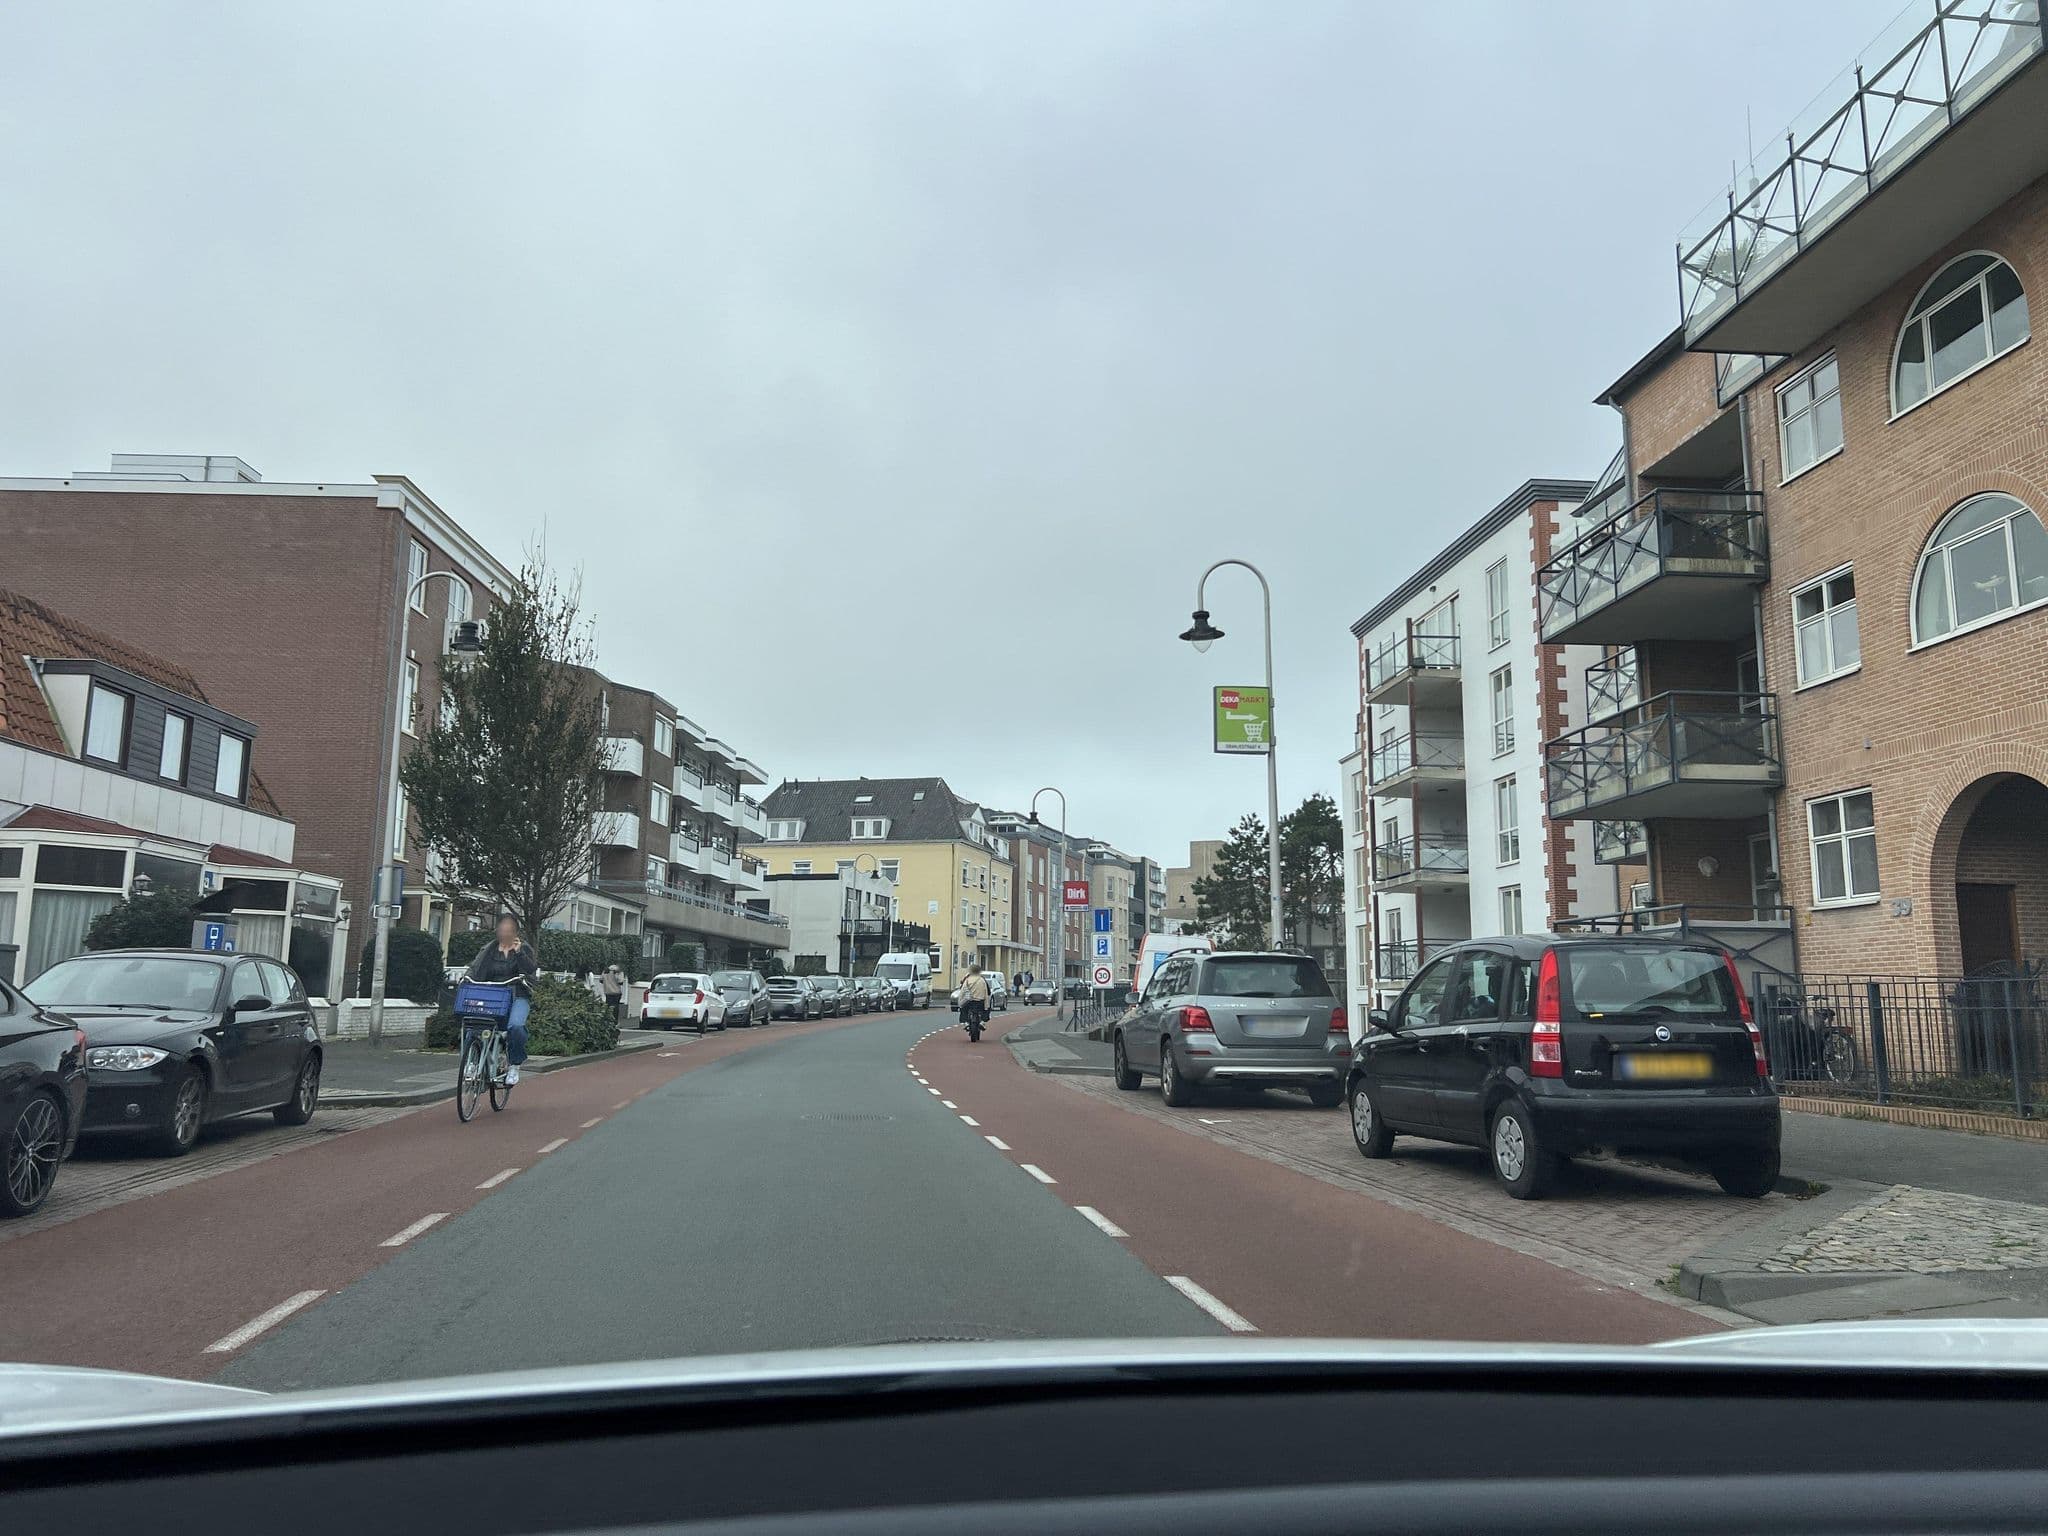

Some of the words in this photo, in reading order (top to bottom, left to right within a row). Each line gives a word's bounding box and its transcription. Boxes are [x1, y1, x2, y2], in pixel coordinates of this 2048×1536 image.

[1067, 888, 1086, 899] Dirk
[1891, 897, 1912, 917] 39
[1099, 940, 1106, 949] P
